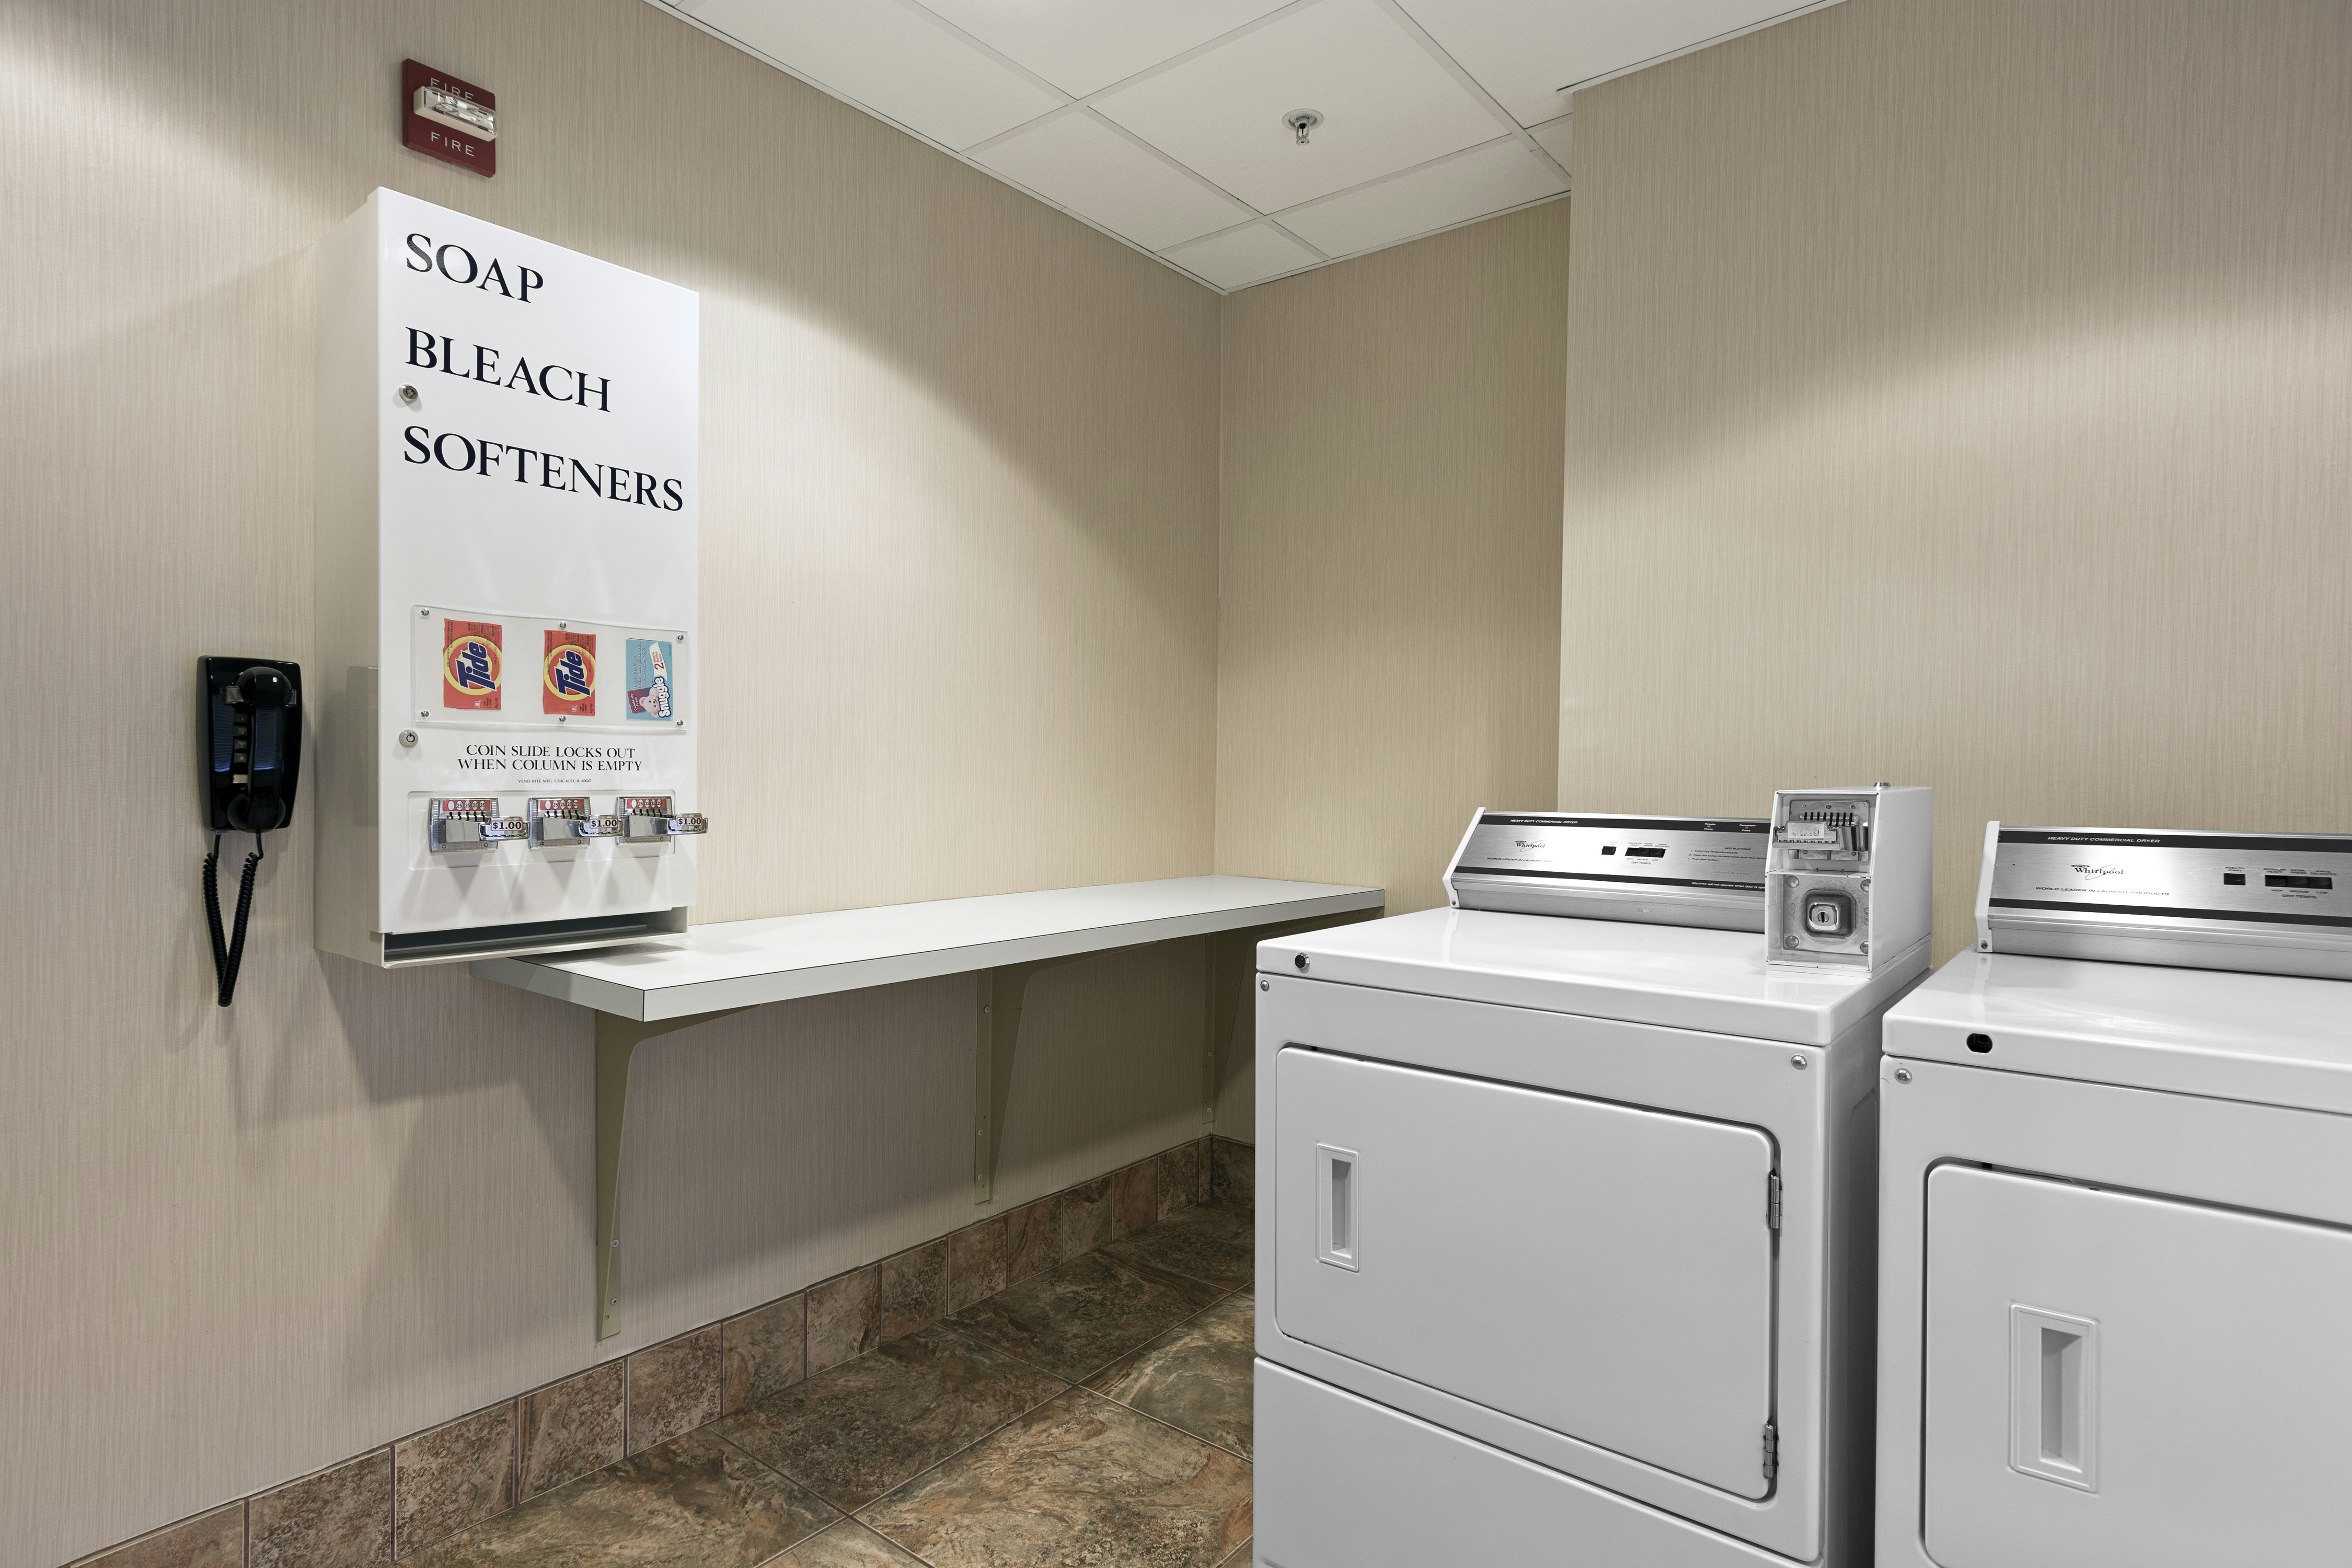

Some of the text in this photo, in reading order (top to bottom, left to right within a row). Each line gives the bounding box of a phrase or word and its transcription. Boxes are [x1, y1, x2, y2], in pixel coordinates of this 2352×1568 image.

[431, 131, 475, 157] FIRE
[406, 233, 544, 303] SOAP
[405, 327, 611, 412] BLEACH
[404, 425, 683, 512] SOFTENERS
[455, 641, 497, 691] Tide
[554, 650, 592, 697] Tide
[652, 676, 671, 718] Snuggle
[458, 759, 642, 771] WHEN COLUMN IS EMPTY
[466, 744, 635, 758] COIN SLIDE LOCKS OUT
[492, 822, 522, 830] $1.00
[2073, 867, 2123, 875] Whirlpool
